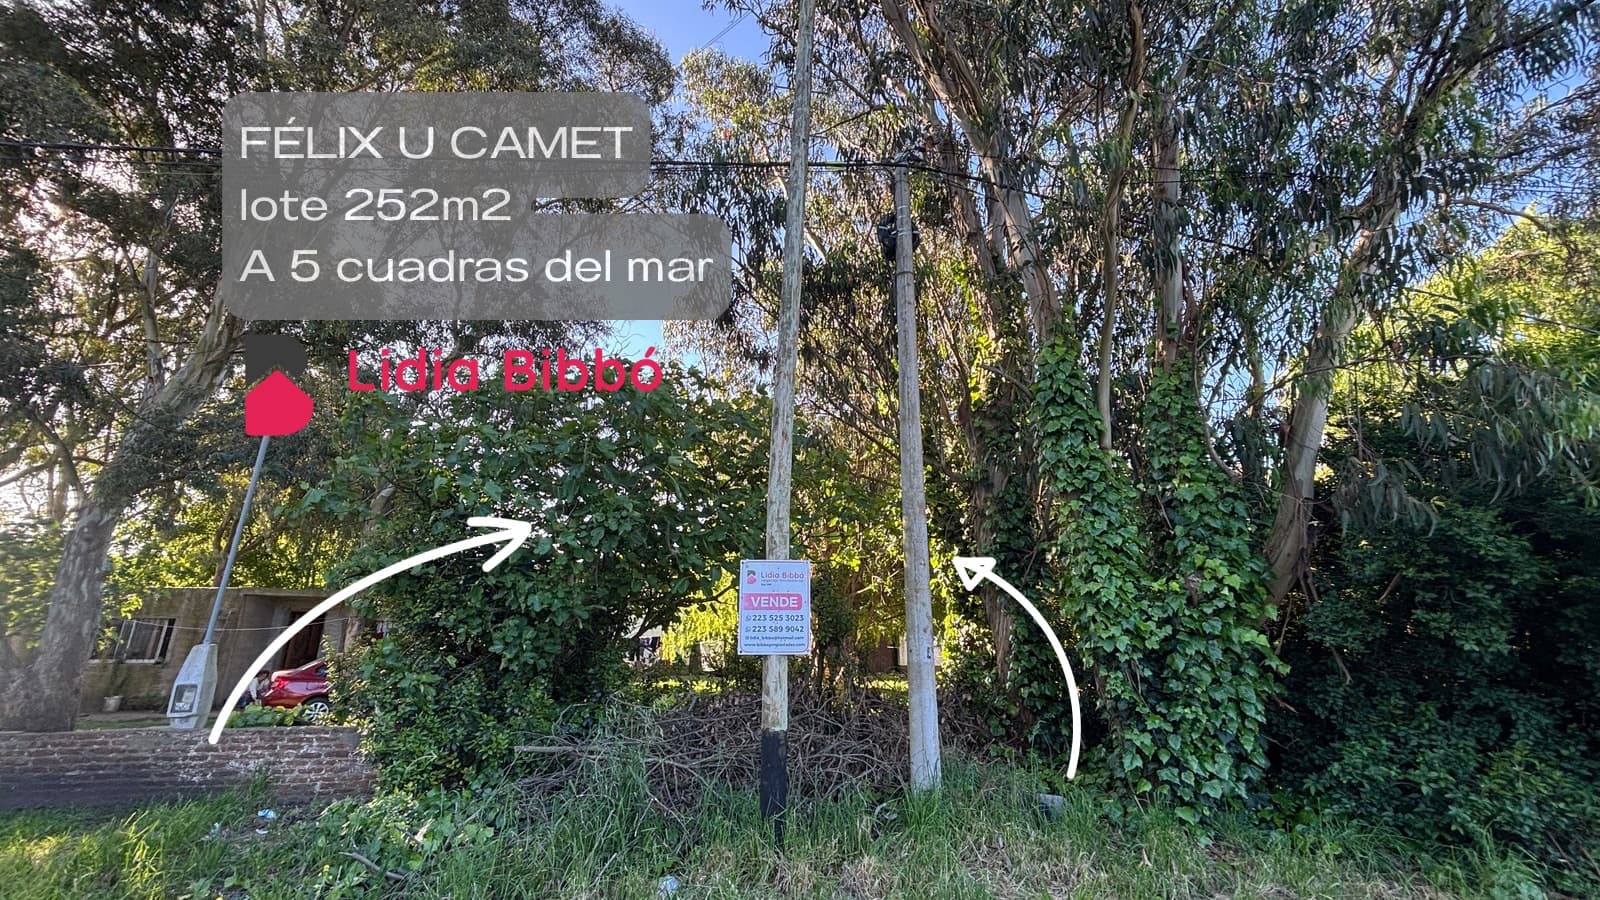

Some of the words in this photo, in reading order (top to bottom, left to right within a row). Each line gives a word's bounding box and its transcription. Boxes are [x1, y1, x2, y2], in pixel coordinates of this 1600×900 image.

[761, 571, 780, 579] Lidia
[751, 596, 798, 608] VENDE
[752, 614, 767, 622] 223
[769, 614, 784, 622] 525
[785, 614, 804, 622] 3023
[752, 625, 767, 633] 223
[769, 625, 783, 633] 589
[785, 625, 804, 633] 9042
